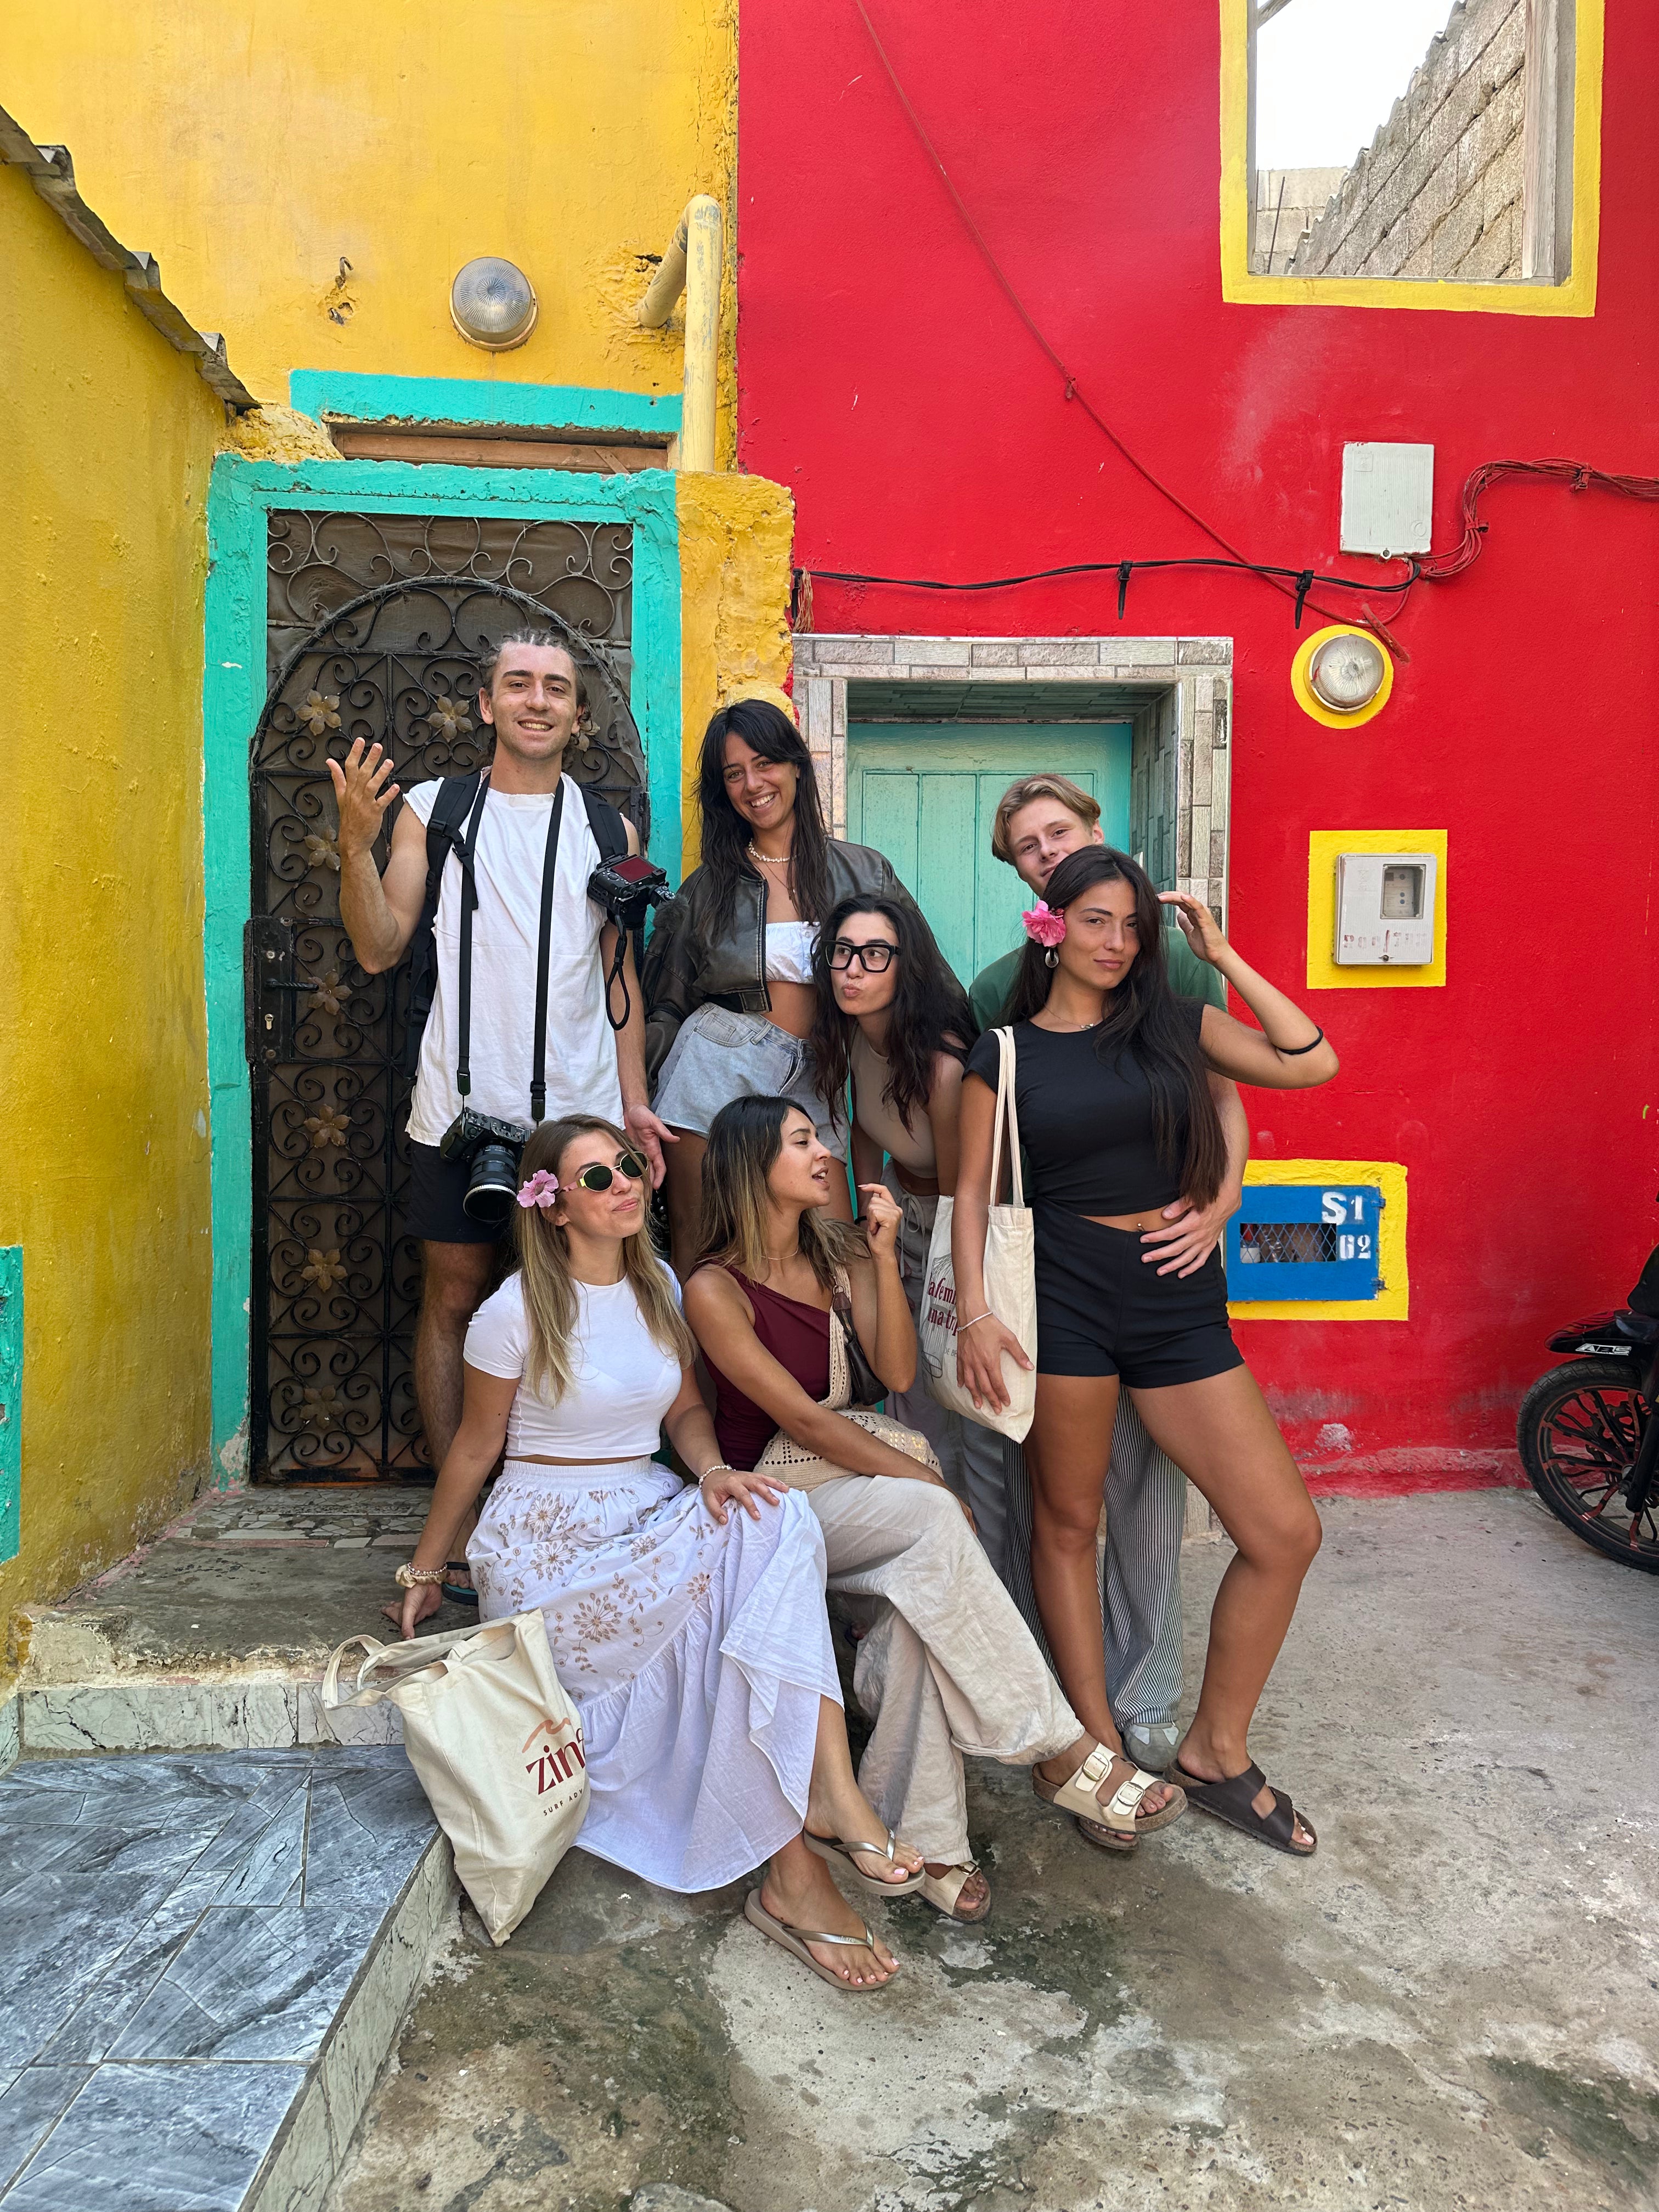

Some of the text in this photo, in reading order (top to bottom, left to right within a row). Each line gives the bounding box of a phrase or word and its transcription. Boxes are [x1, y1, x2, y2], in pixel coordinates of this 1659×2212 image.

[1322, 1192, 1363, 1225] S1
[1575, 1343, 1632, 1356] ABS
[543, 1800, 563, 1816] SURF
